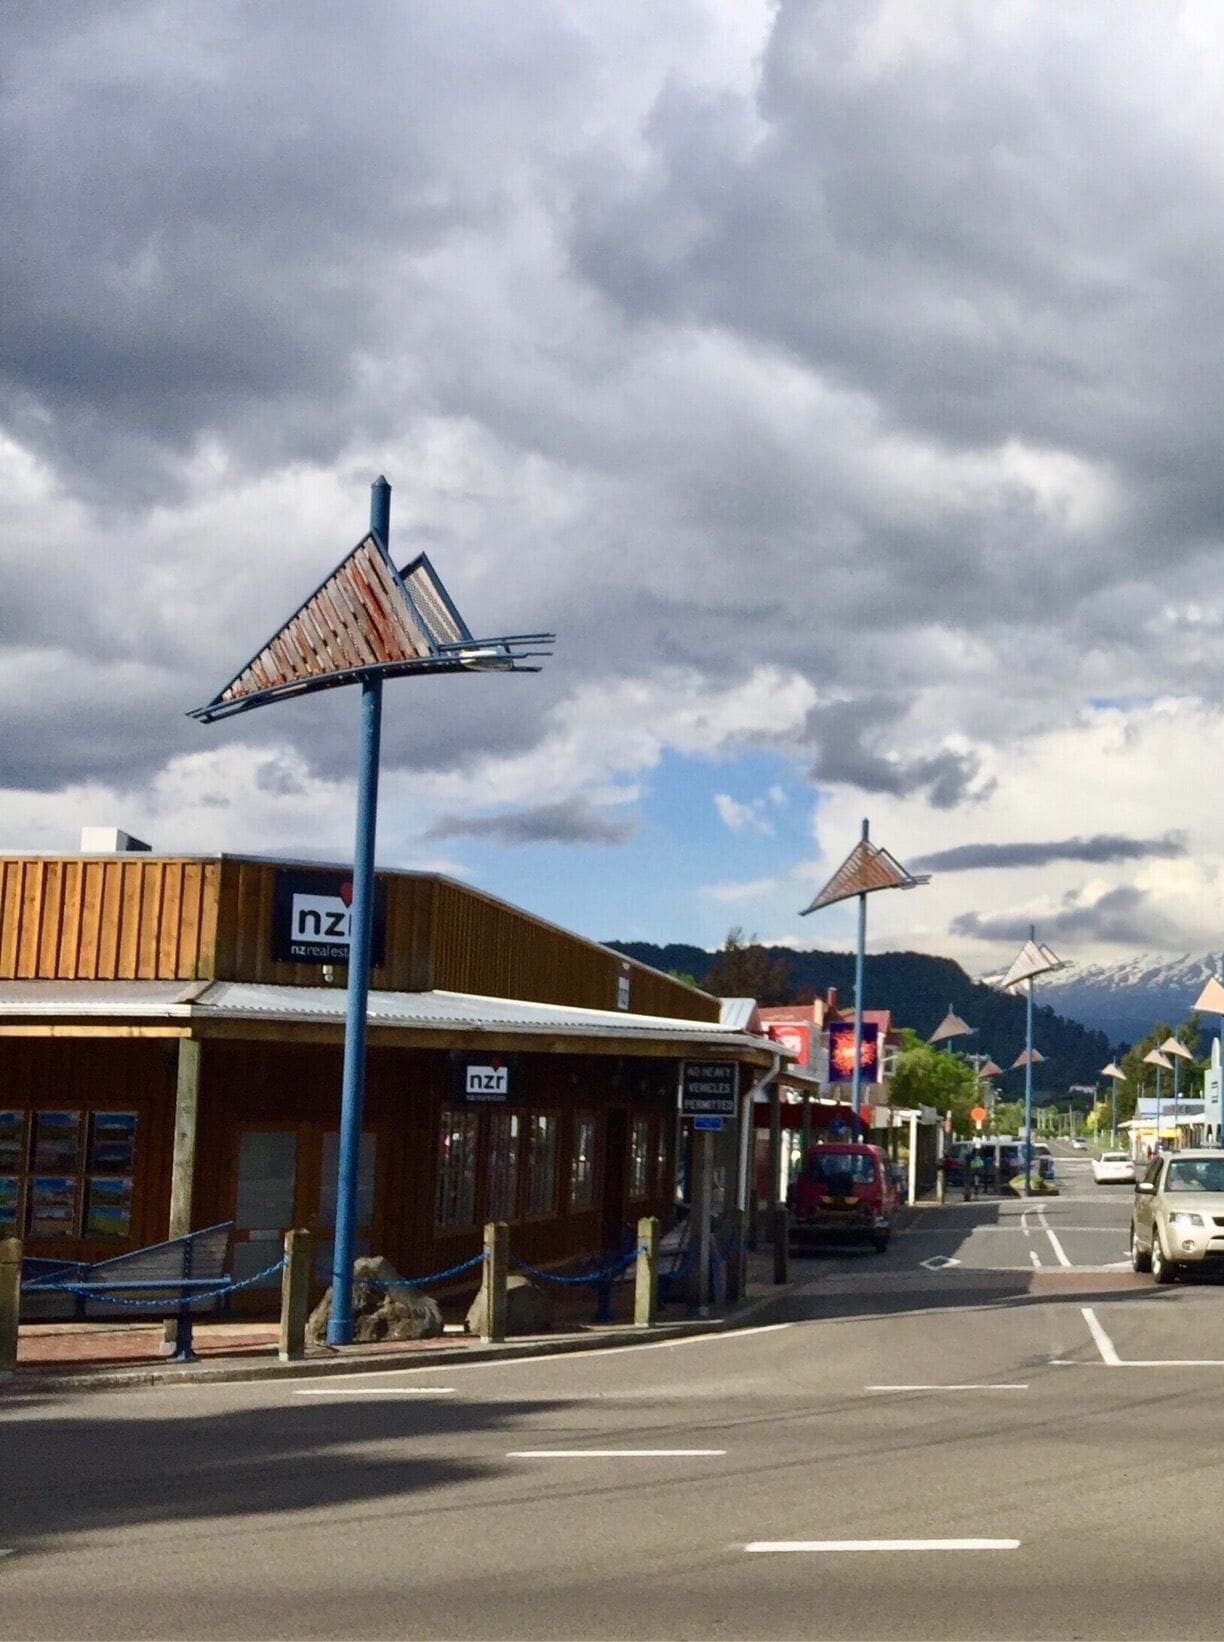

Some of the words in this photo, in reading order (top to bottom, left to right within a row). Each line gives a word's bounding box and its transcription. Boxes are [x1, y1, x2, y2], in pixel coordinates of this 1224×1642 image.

[298, 909, 352, 937] nz
[470, 1075, 504, 1089] nzr
[688, 1083, 730, 1093] VEHICLES
[684, 1099, 734, 1110] PERMITTED
